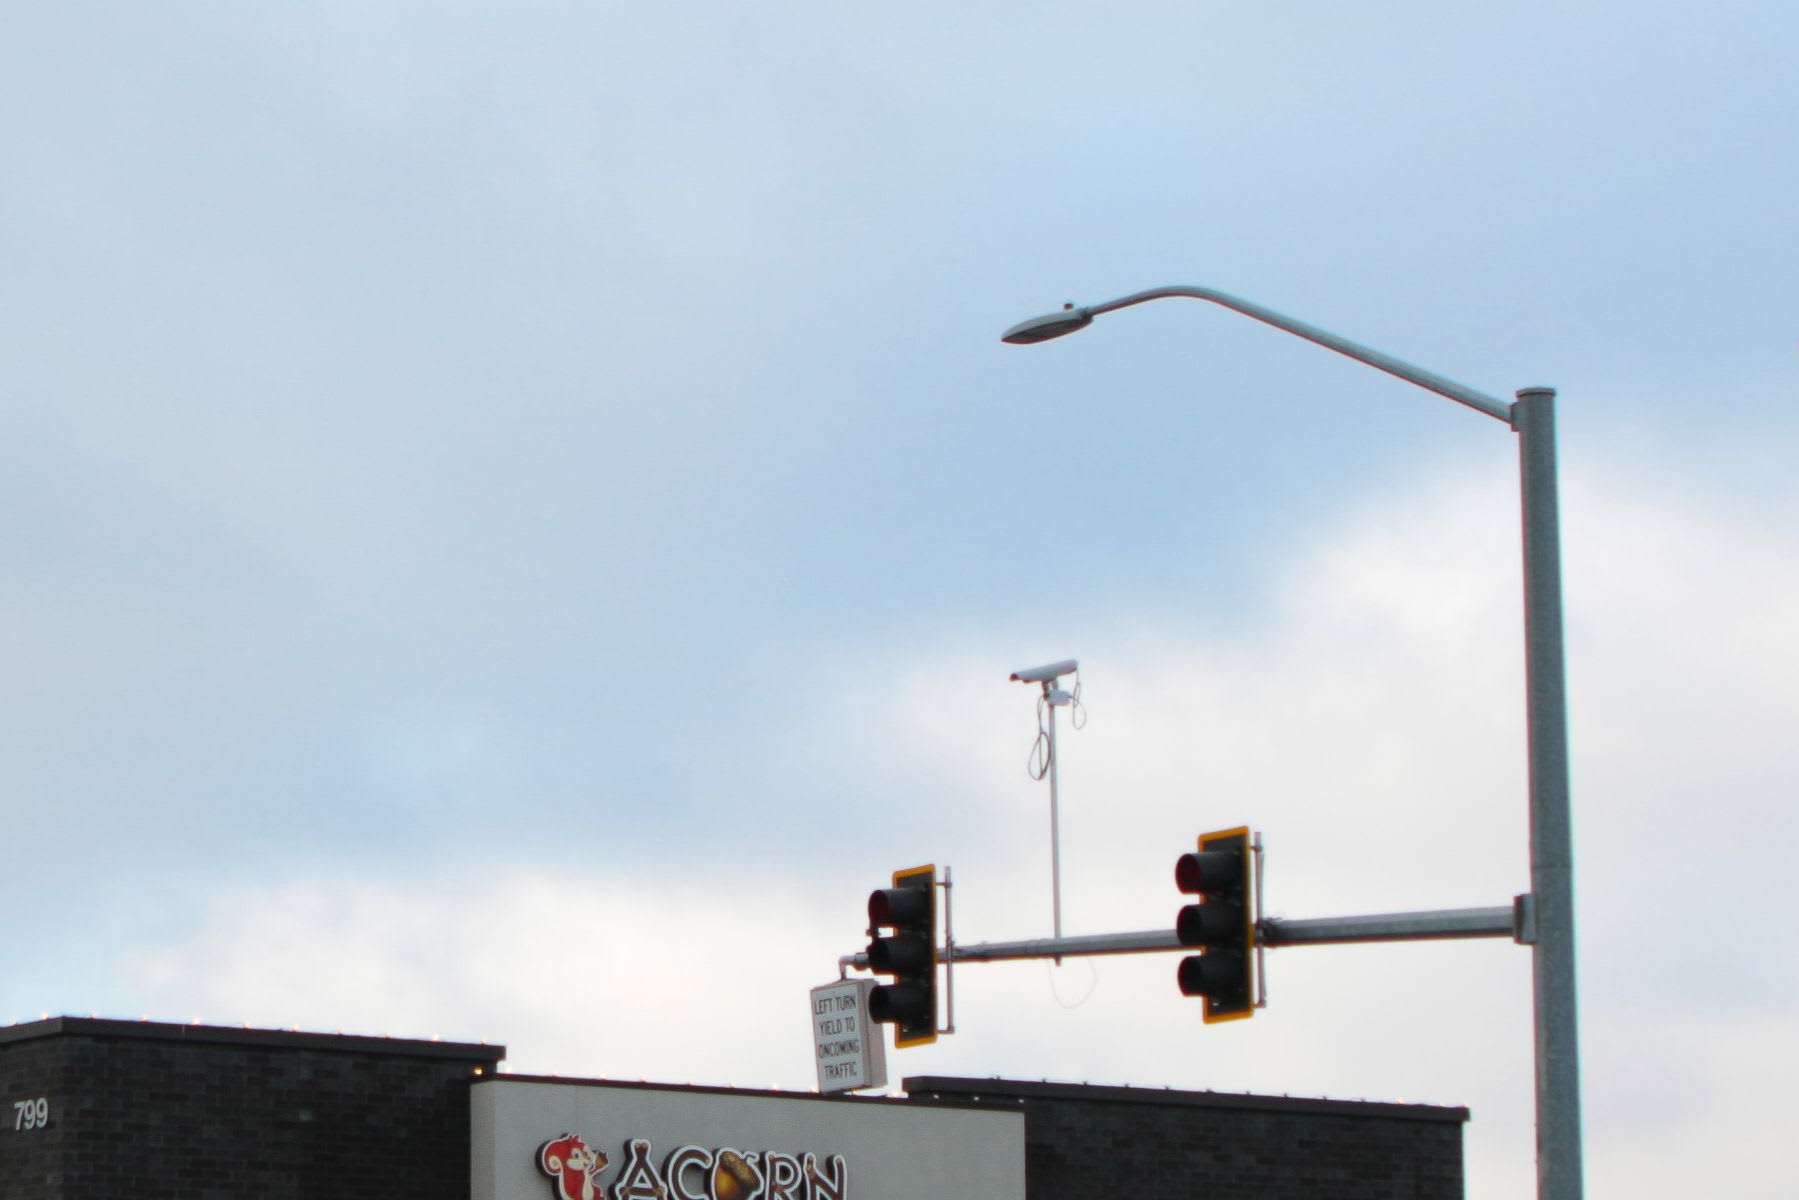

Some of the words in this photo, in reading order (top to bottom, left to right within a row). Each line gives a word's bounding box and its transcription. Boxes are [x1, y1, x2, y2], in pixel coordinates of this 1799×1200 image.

[814, 998, 833, 1015] LEFT
[834, 994, 856, 1012] TURN
[819, 1019, 842, 1036] YIELD
[845, 1016, 855, 1032] TO
[818, 1039, 860, 1058] ONCOMING
[825, 1062, 857, 1079] TRAFFIC
[14, 1098, 48, 1131] 799
